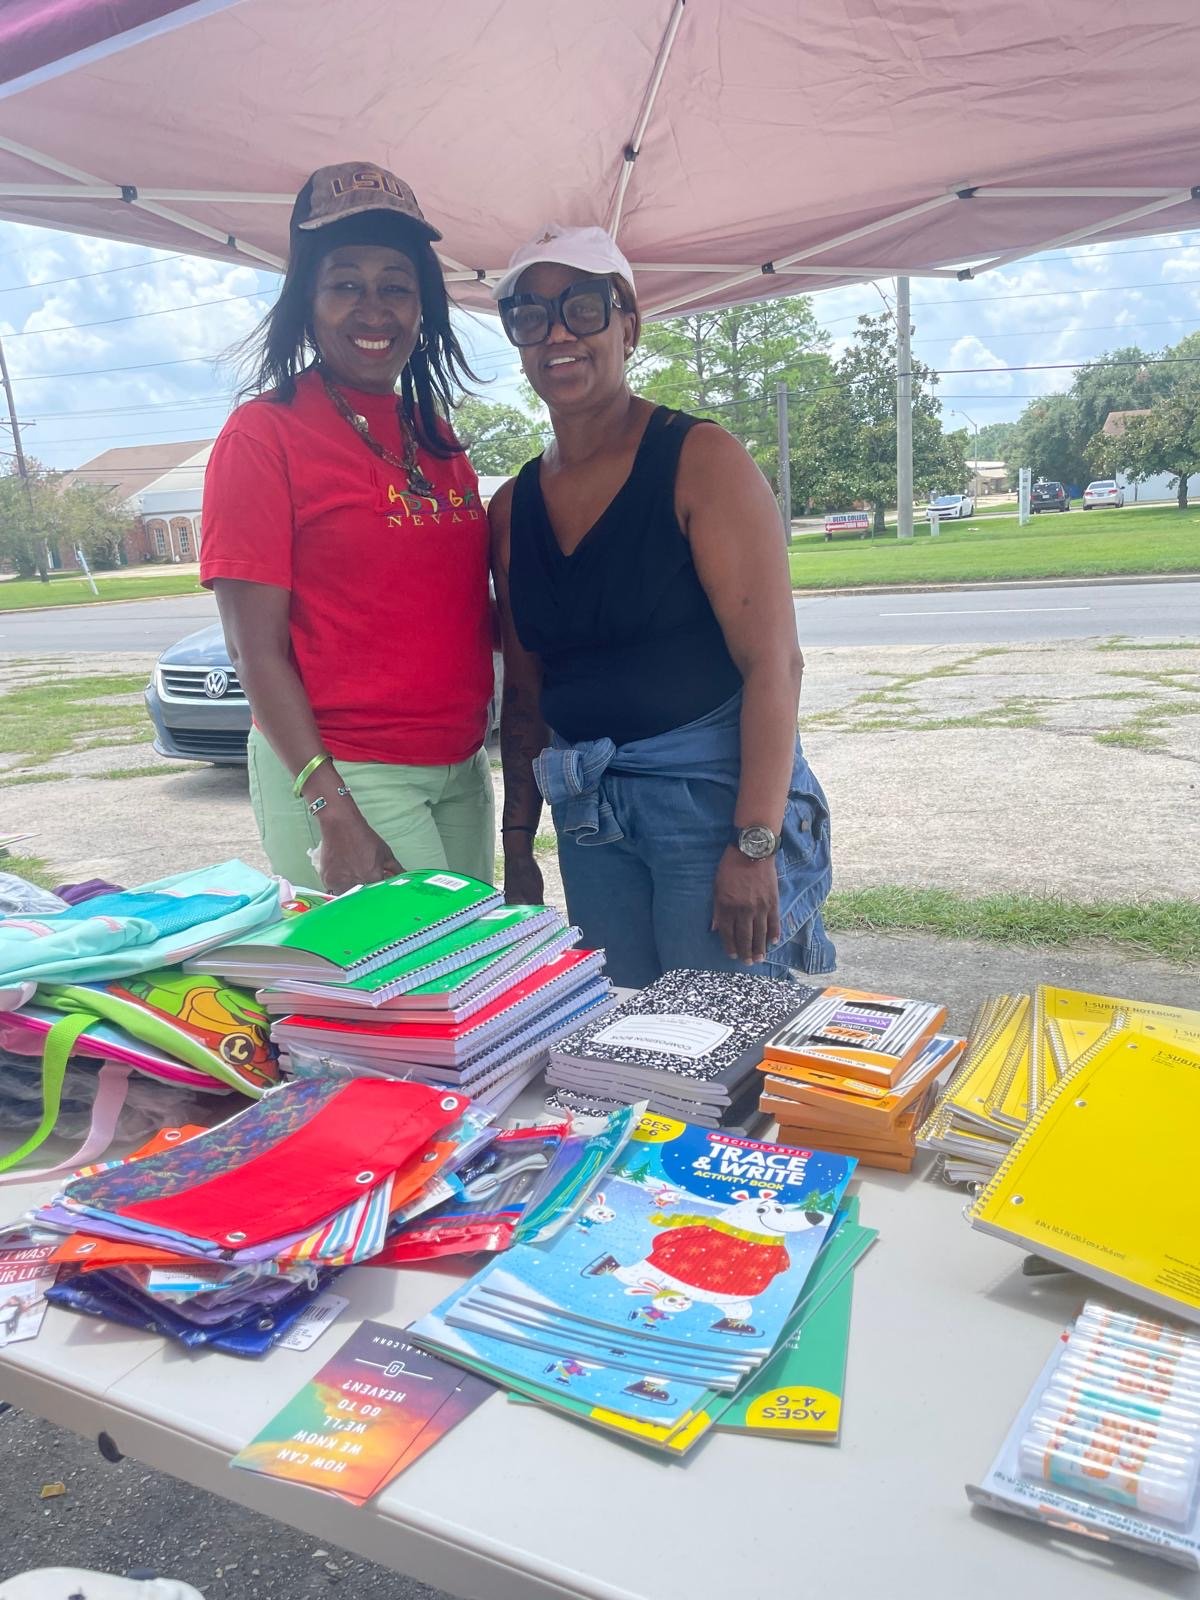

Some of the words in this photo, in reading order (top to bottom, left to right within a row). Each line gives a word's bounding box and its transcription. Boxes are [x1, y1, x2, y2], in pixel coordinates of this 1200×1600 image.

[331, 172, 404, 200] LSU
[387, 509, 479, 528] NEVAD
[1157, 1050, 1200, 1070] 1-SUBJE
[640, 1117, 672, 1132] GES
[722, 1137, 810, 1158] SCHOLASTIC
[709, 1142, 809, 1172] TRACE
[691, 1156, 712, 1170] &
[719, 1160, 807, 1186] WRITE
[693, 1170, 749, 1185] ACTIVITY
[749, 1179, 785, 1191] BOOK
[15, 1246, 57, 1261] WAST
[372, 1336, 413, 1352] ALCORN
[342, 1379, 407, 1403] HEAVEN?
[337, 1398, 357, 1412] TO
[775, 1394, 817, 1407] 4-6
[360, 1404, 382, 1417] GO
[761, 1407, 826, 1420] AGES
[323, 1415, 367, 1434] WE'LL
[293, 1429, 339, 1449] KNOW
[340, 1441, 363, 1455] WE
[276, 1447, 310, 1464] CAN
[310, 1456, 347, 1473] HOW
